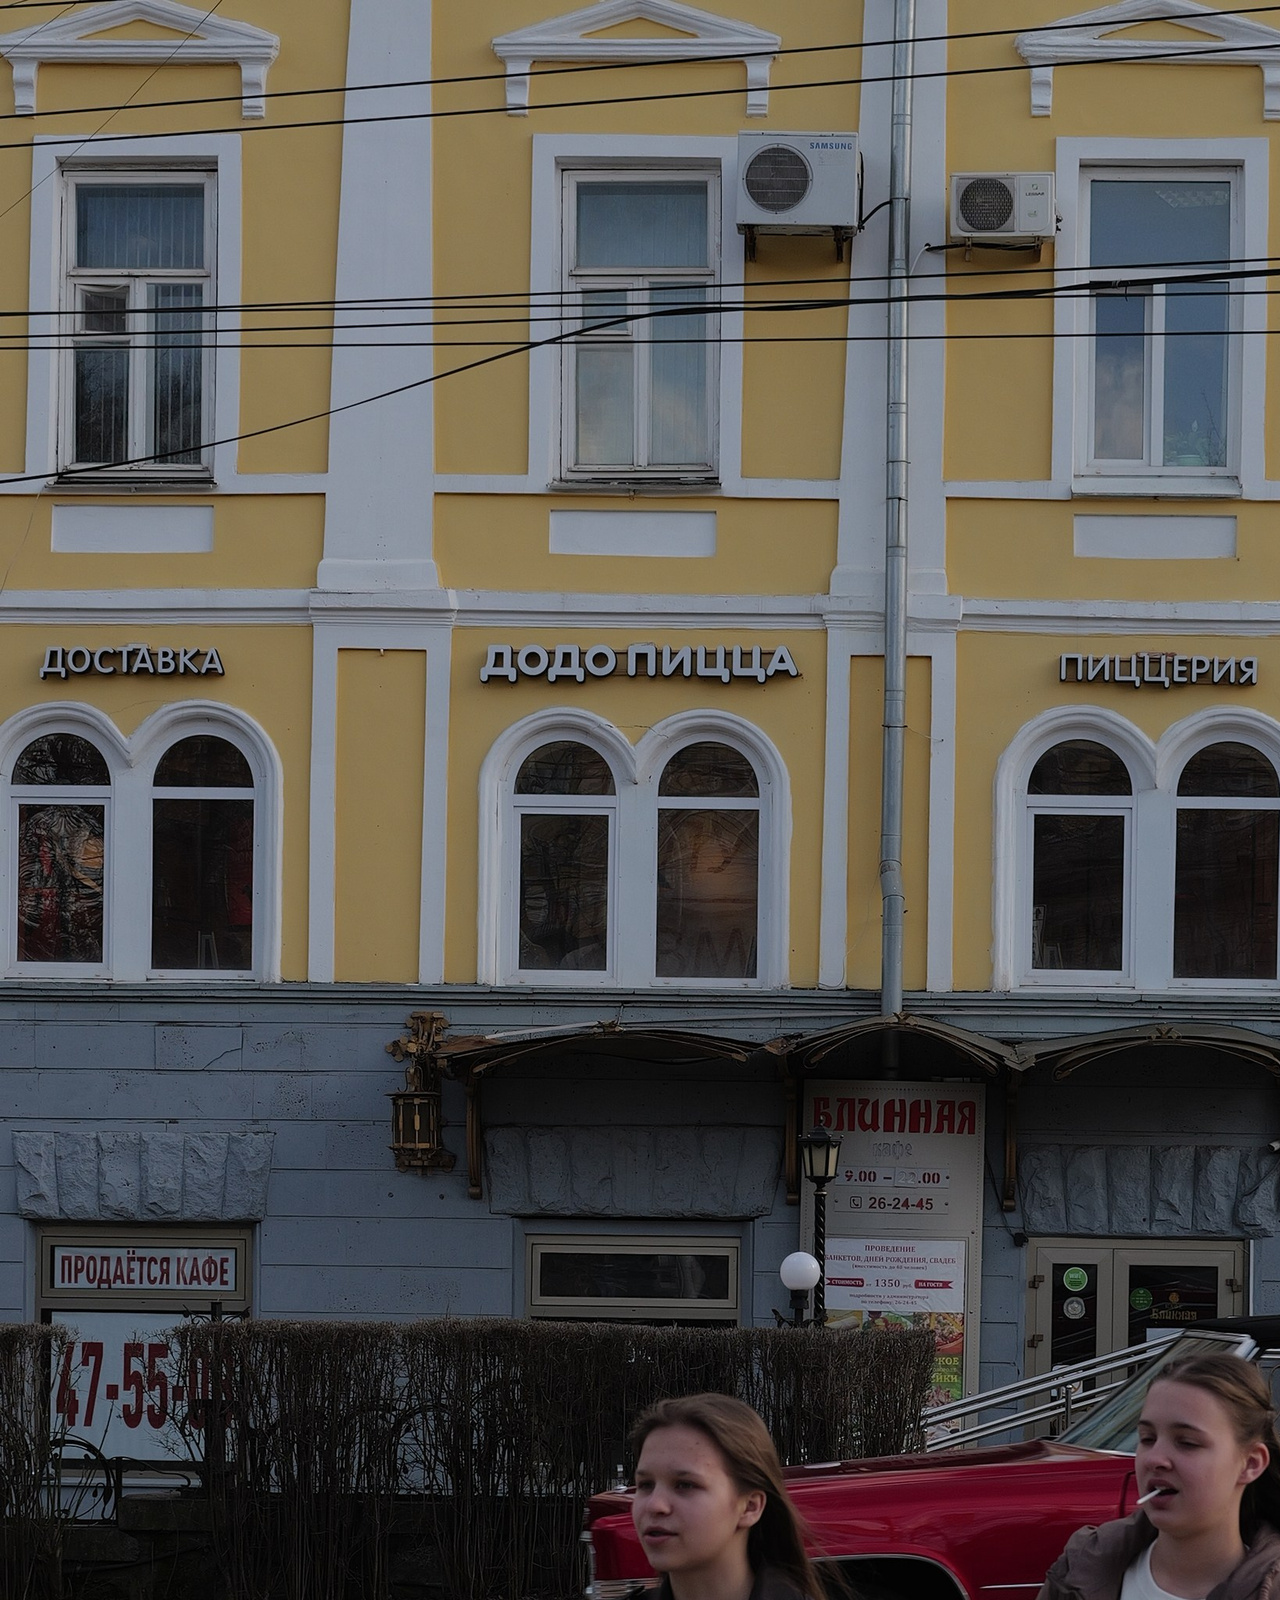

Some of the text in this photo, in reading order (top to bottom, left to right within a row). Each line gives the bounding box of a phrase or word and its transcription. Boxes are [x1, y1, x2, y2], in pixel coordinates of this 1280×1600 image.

[809, 142, 853, 150] SAMSUNG
[39, 645, 225, 680] ДОСТАВКА
[480, 644, 800, 684] ДОДО ПИЦЦА
[1060, 653, 1259, 689] ПИЦЦЕРИЯ
[812, 1096, 977, 1135] БЛИННАЯ
[844, 1170, 877, 1183] 9.00
[899, 1171, 941, 1185] 22.00
[868, 1196, 934, 1211] 26-24-45
[864, 1245, 916, 1253] ПРОВЕДЕНИЕ
[60, 1250, 230, 1289] ПРОДАЁТСЯ КАФЕ
[875, 1279, 901, 1288] 1350
